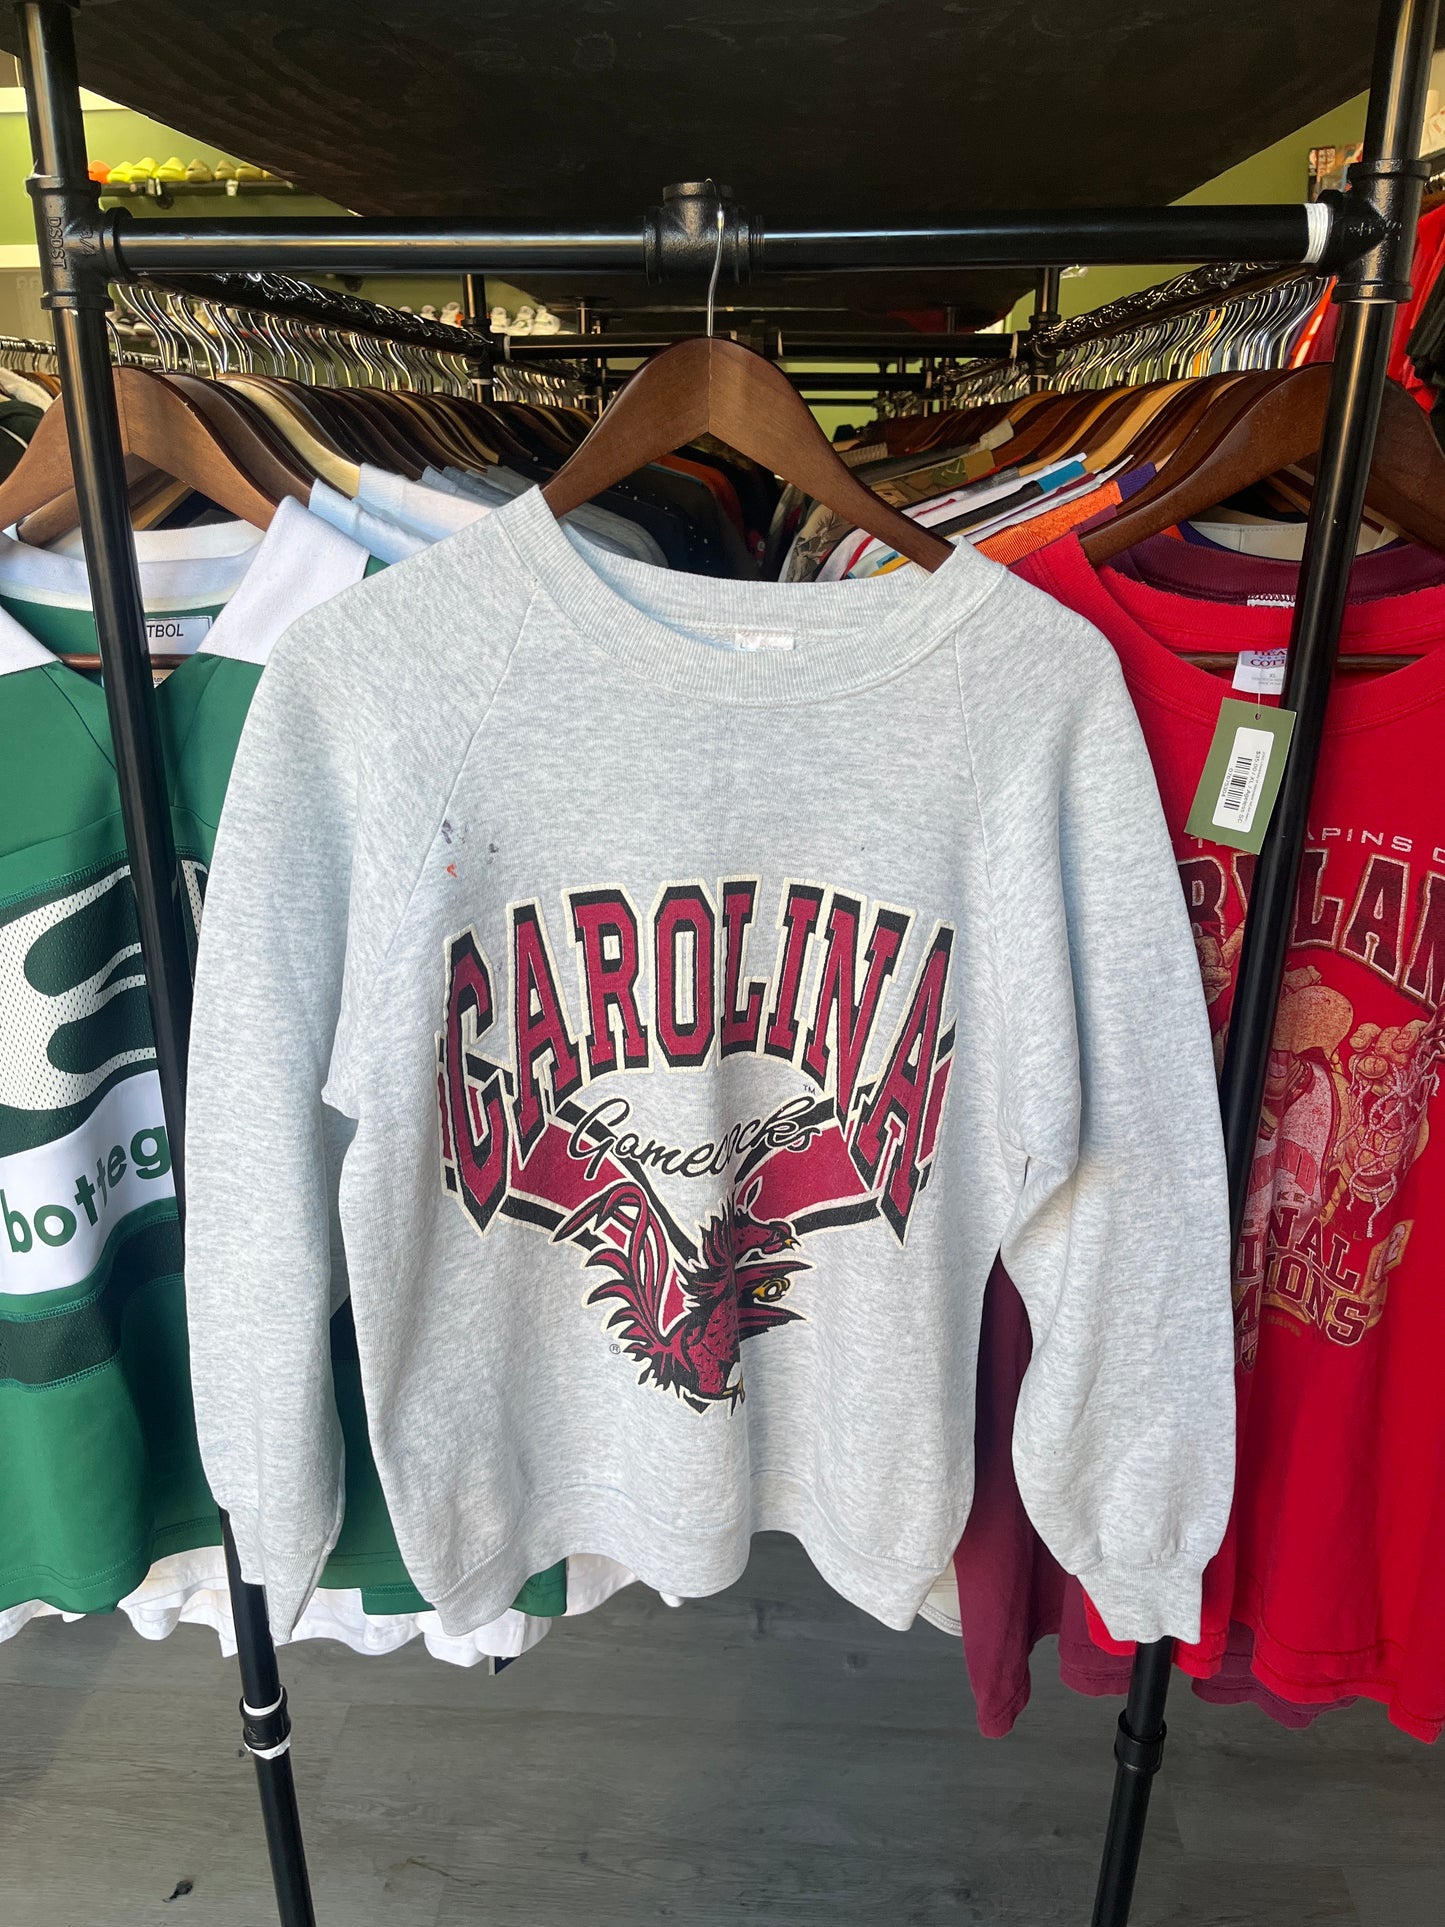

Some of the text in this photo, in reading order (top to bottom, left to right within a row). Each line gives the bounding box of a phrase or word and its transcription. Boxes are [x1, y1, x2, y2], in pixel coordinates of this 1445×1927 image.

[47, 216, 67, 269] DSDST
[146, 624, 184, 638] TBOL
[1250, 659, 1285, 667] COTT
[444, 876, 956, 1247] CAROLINA
[567, 1095, 823, 1181] Gamecocks
[0, 1125, 172, 1253] botteg
